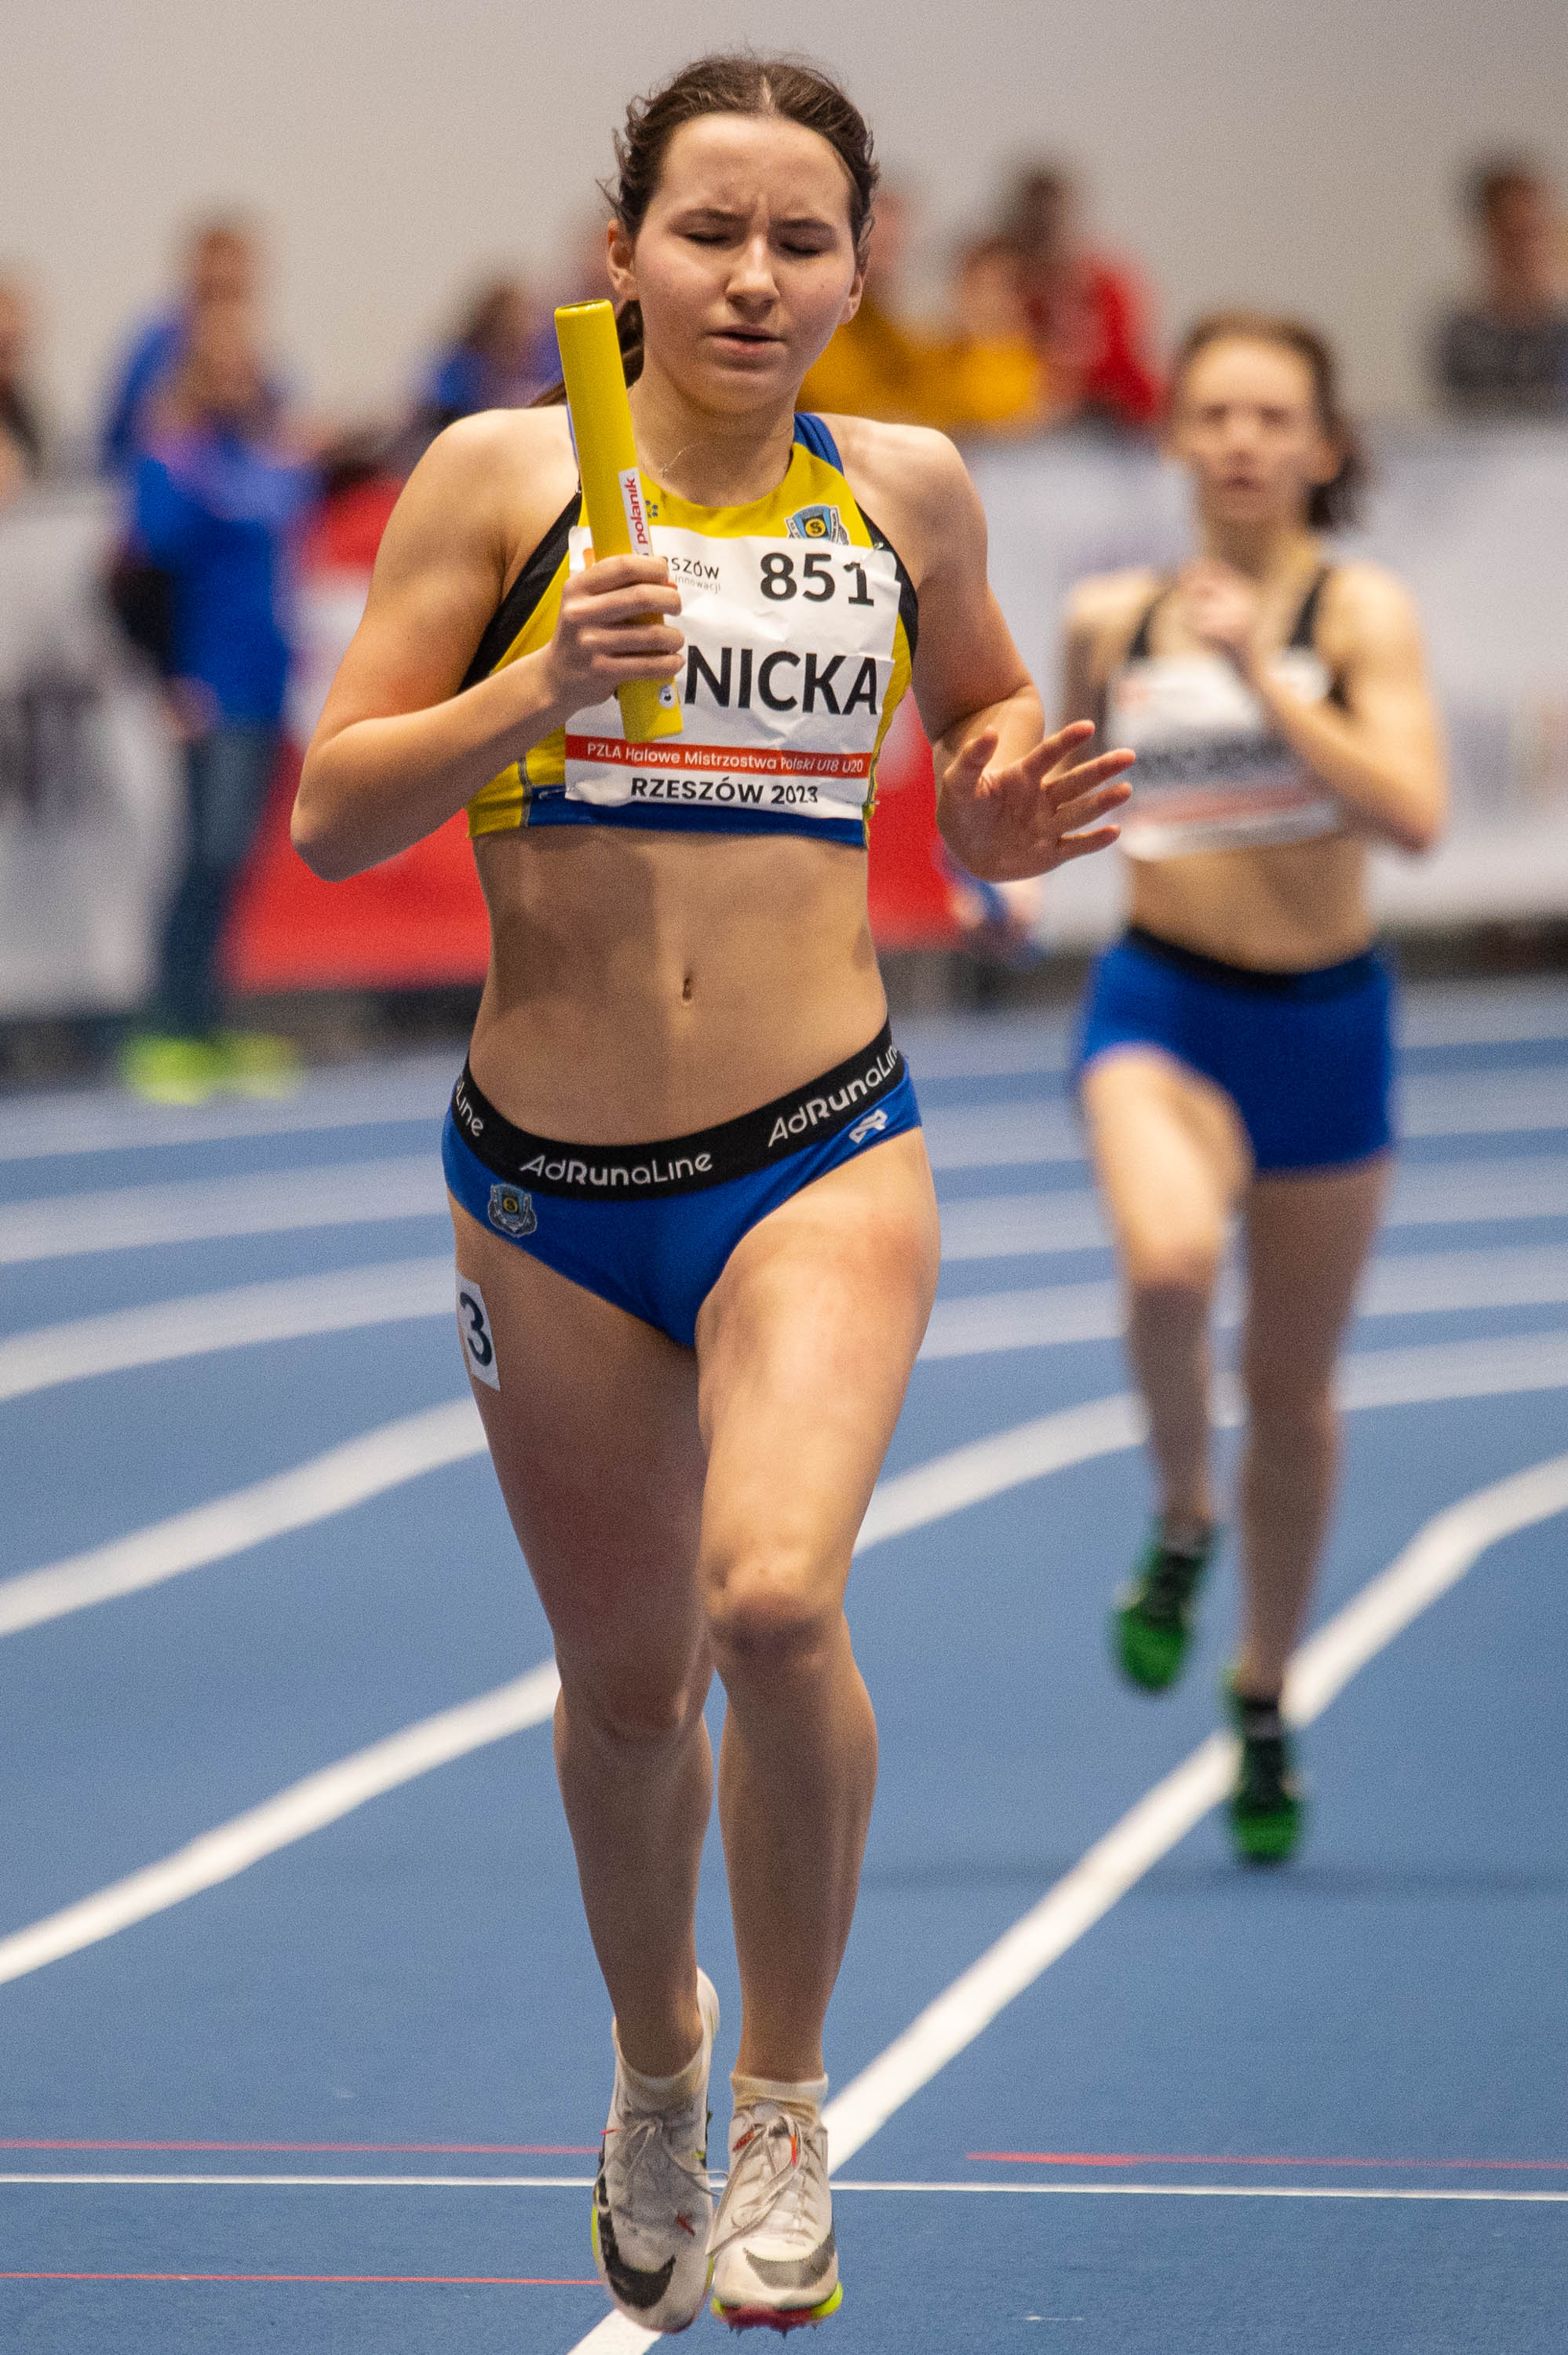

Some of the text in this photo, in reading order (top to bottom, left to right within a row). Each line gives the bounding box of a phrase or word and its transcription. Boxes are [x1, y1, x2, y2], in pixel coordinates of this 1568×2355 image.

[624, 477, 648, 545] polanik
[759, 552, 874, 607] 851
[587, 743, 863, 773] PZLA Halowe Mistrzostwa Polski U18 U20
[630, 776, 818, 805] RZESZÓW 2023
[456, 1079, 483, 1137] Line
[768, 1044, 899, 1148] AdRunaLin
[459, 1291, 493, 1367] 3
